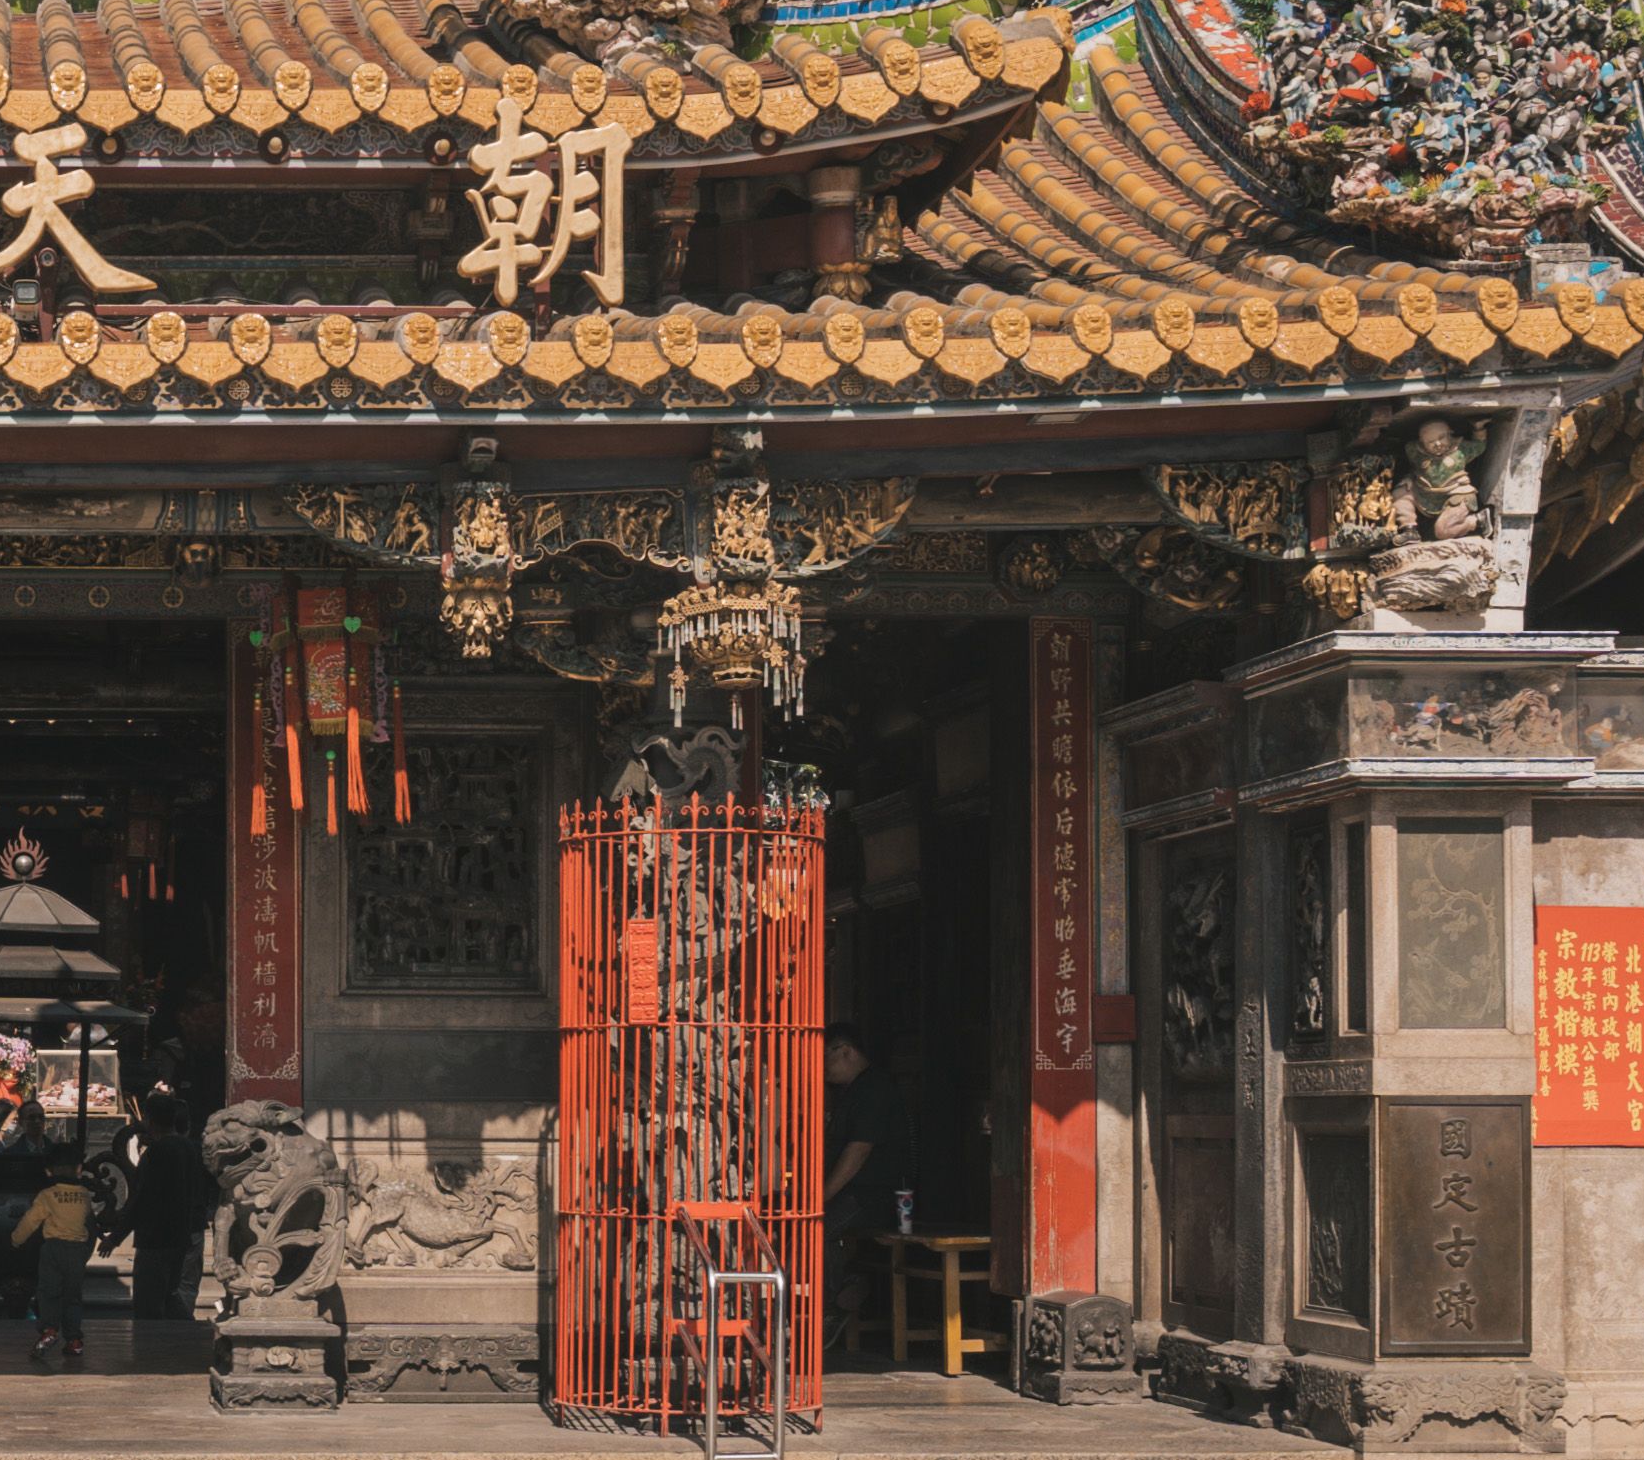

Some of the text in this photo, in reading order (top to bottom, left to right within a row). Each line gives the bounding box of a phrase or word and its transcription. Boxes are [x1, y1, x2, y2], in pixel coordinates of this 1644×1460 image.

[1554, 929, 1581, 1077] 宗教楷模
[1625, 944, 1644, 1132] 北港朝天宮
[1433, 1119, 1479, 1332] 國定古蹟
